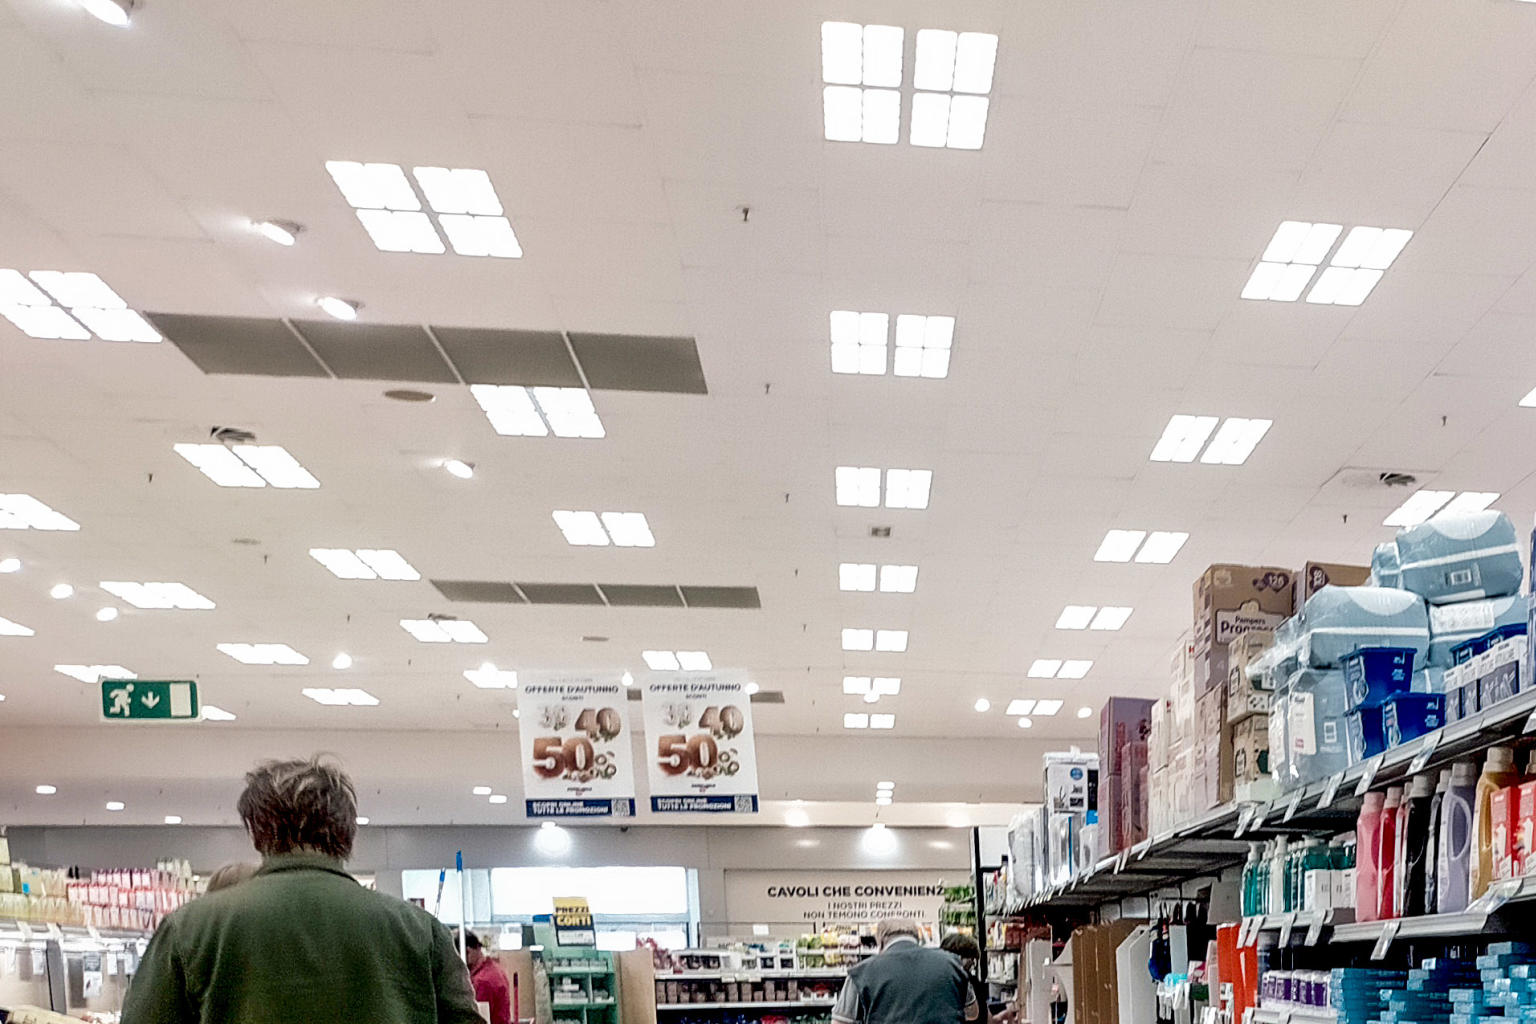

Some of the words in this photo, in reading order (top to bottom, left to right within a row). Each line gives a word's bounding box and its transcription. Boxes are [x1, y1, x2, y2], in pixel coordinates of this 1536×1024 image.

[525, 684, 564, 694] OFFERTE
[649, 683, 689, 693] OFFERTE
[574, 707, 622, 741] 40
[698, 705, 744, 739] 40
[767, 886, 819, 898] CAVOLI
[822, 886, 851, 897] CHE
[854, 885, 945, 896] CONVENIENZ
[555, 905, 590, 914] PREZZI
[869, 901, 902, 909] PREZZI
[803, 911, 825, 919] NON
[828, 911, 867, 919] TEMONO
